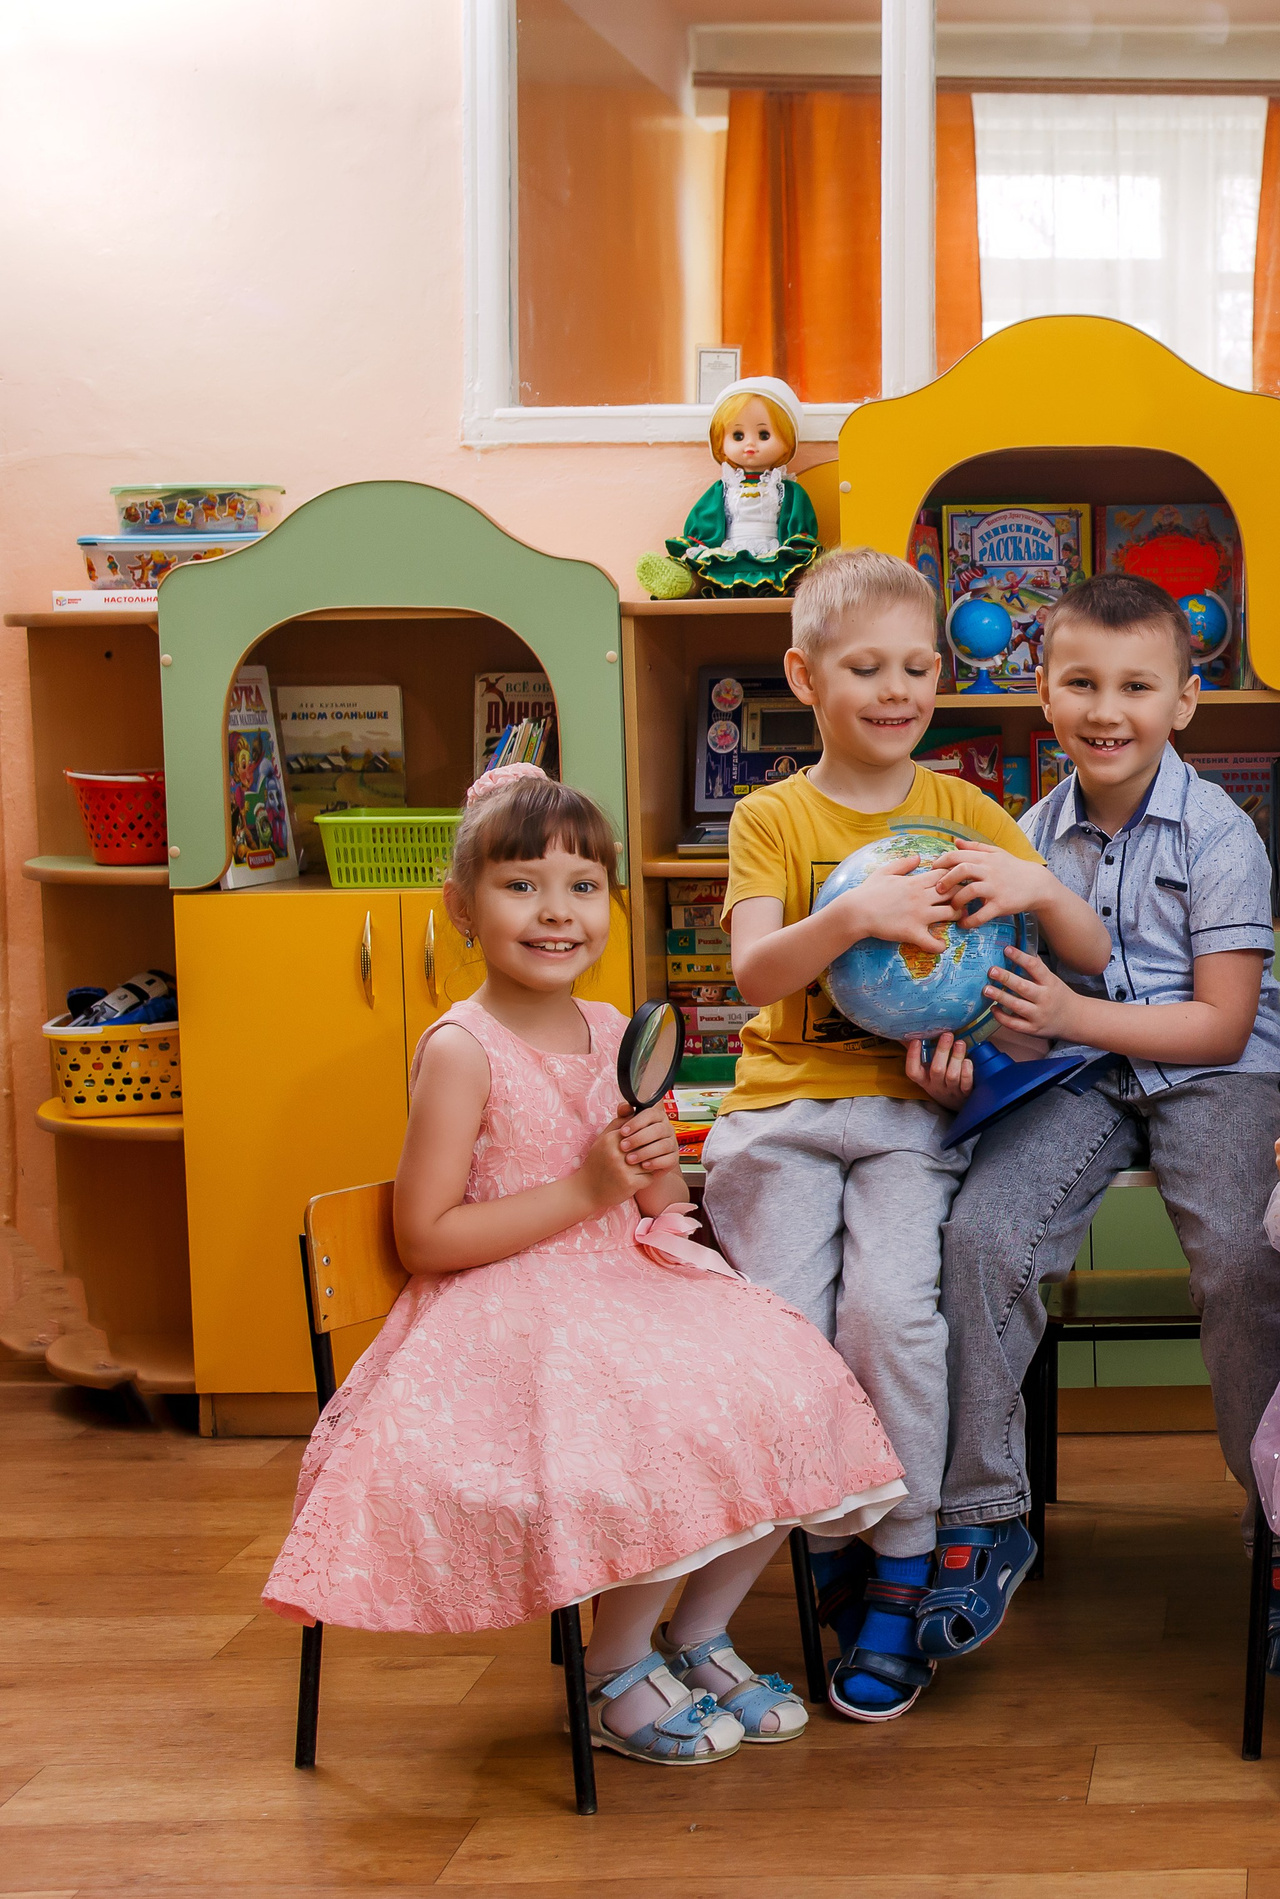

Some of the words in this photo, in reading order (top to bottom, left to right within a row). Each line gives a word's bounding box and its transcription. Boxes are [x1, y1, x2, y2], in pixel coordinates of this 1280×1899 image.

[978, 523, 1053, 546] ДЕНИСКИНЫ
[978, 536, 1054, 562] РАССКАЗЫ
[505, 680, 530, 693] ВСЁ
[230, 685, 267, 713] УКА
[291, 711, 328, 720] ЯСНОМ
[330, 710, 389, 720] СОЛНЫШКЕ
[1221, 771, 1271, 781] УРОКИ
[686, 963, 721, 973] Puzzle
[727, 1013, 742, 1021] 104
[844, 1042, 861, 1051] NEW
